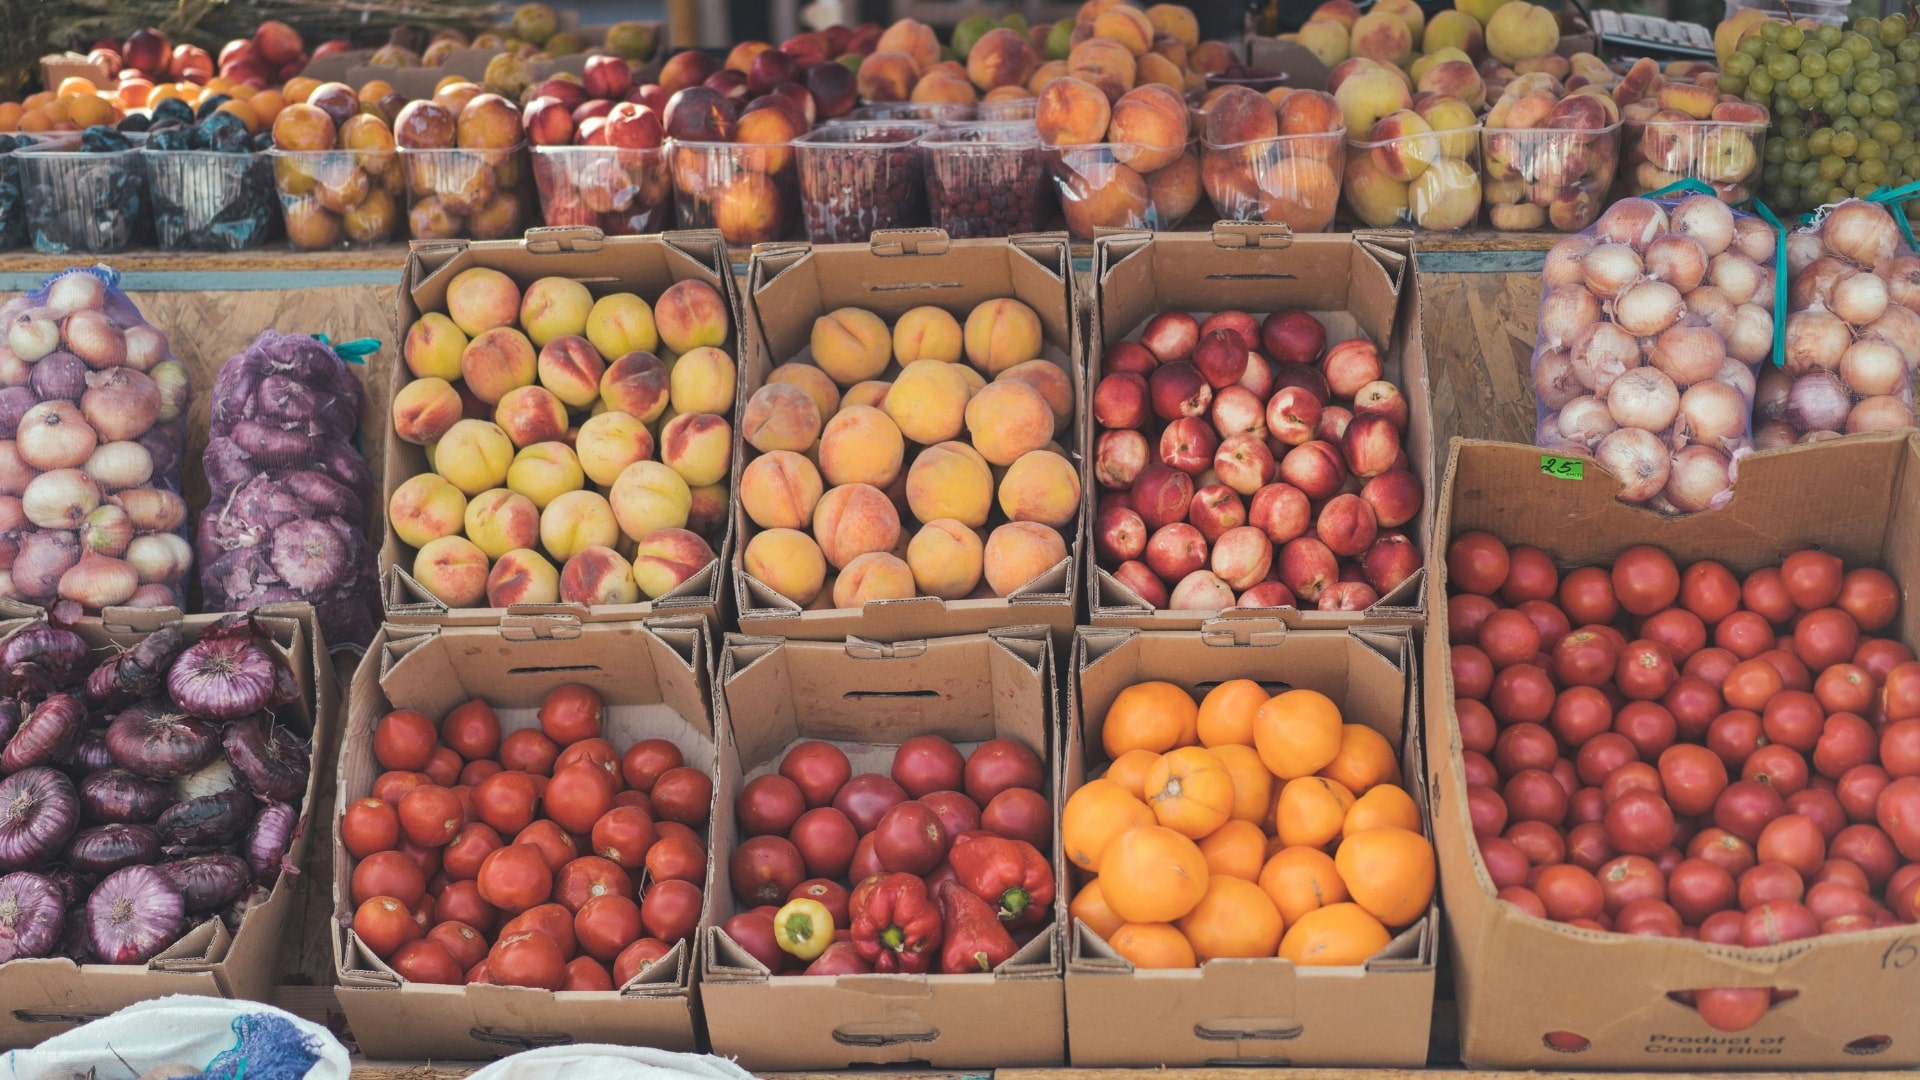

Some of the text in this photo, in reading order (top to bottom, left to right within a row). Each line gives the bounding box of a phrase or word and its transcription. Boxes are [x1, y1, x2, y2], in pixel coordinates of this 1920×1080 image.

[1541, 458, 1582, 474] 25
[1650, 1034, 1787, 1045] Product of
[1644, 1044, 1783, 1055] Costa Rica
